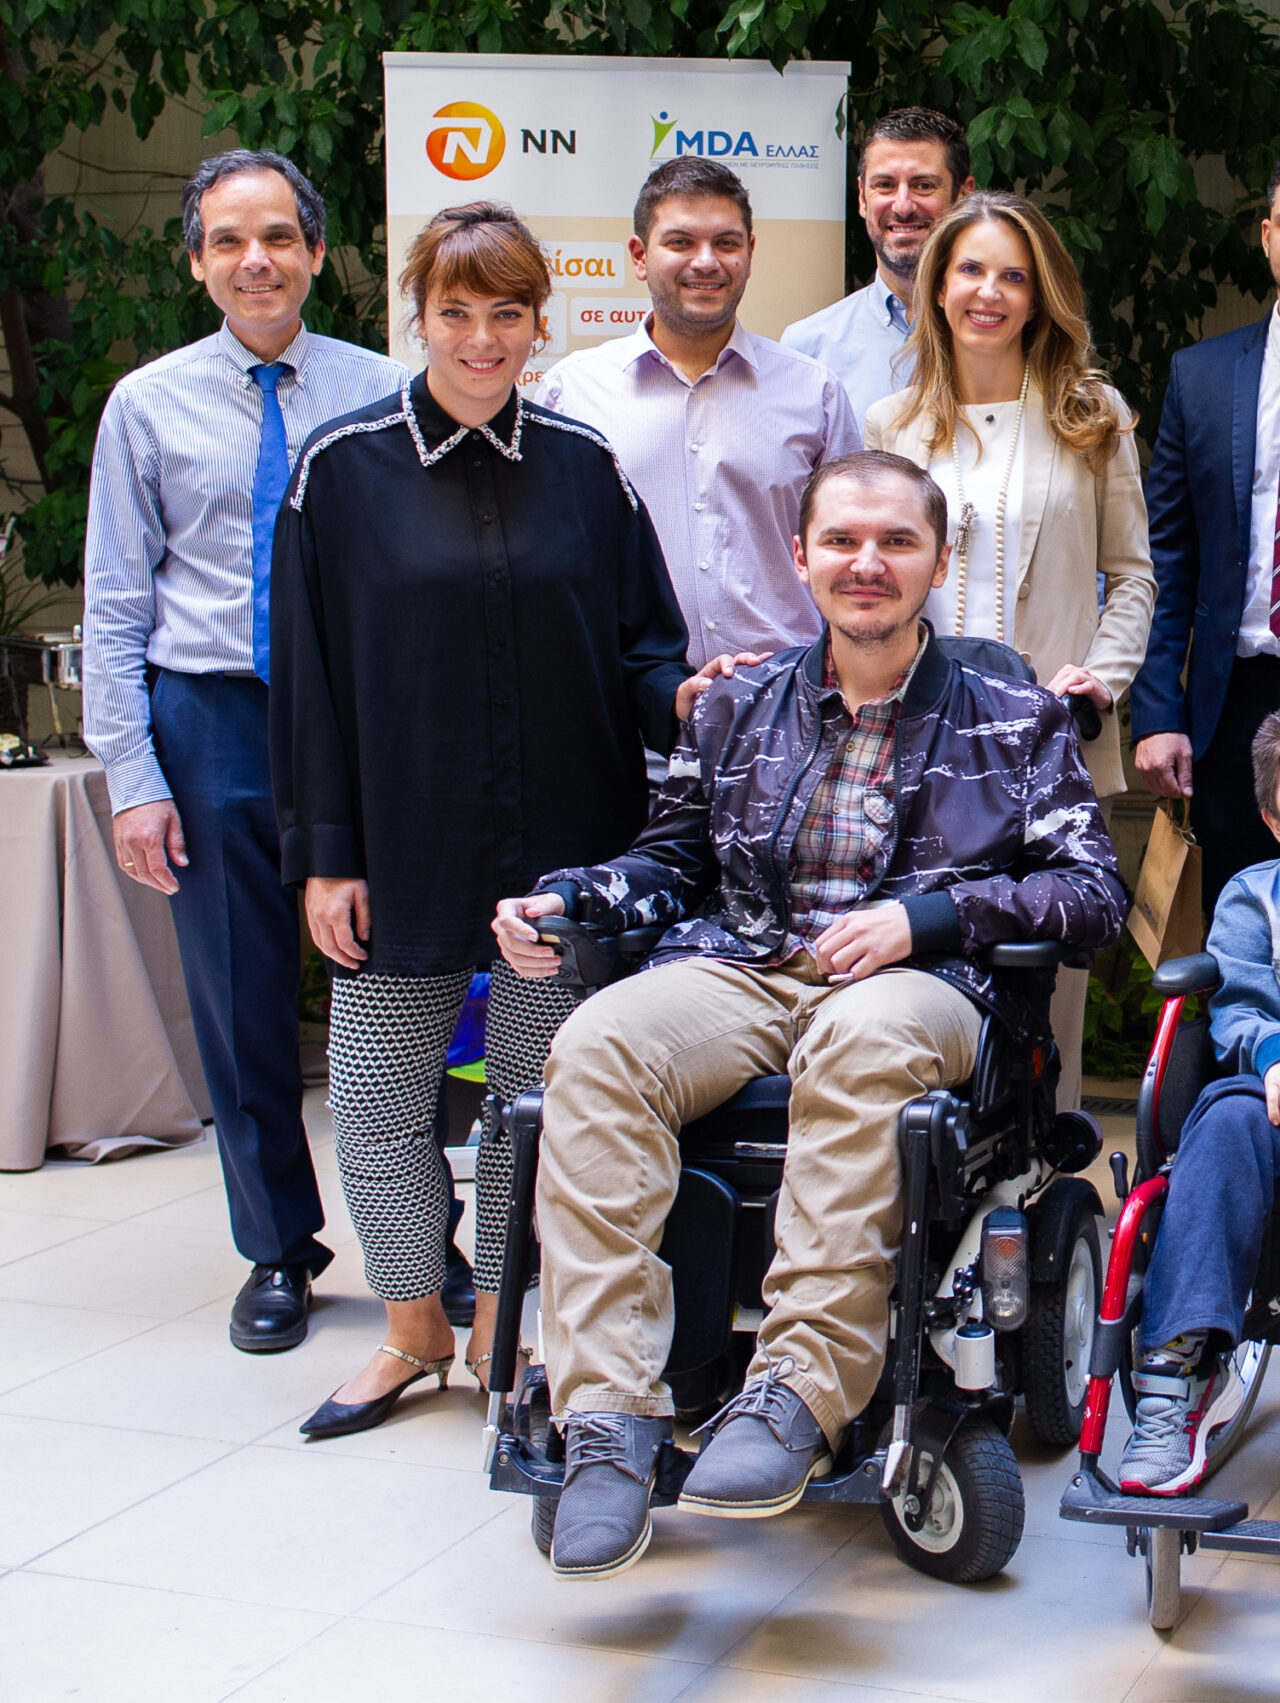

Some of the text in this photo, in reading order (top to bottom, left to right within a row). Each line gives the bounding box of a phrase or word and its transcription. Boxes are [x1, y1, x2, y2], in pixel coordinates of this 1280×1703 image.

[520, 128, 576, 154] NN
[675, 130, 819, 158] MDA ΕΛΛΑΣ
[580, 310, 604, 323] σε
